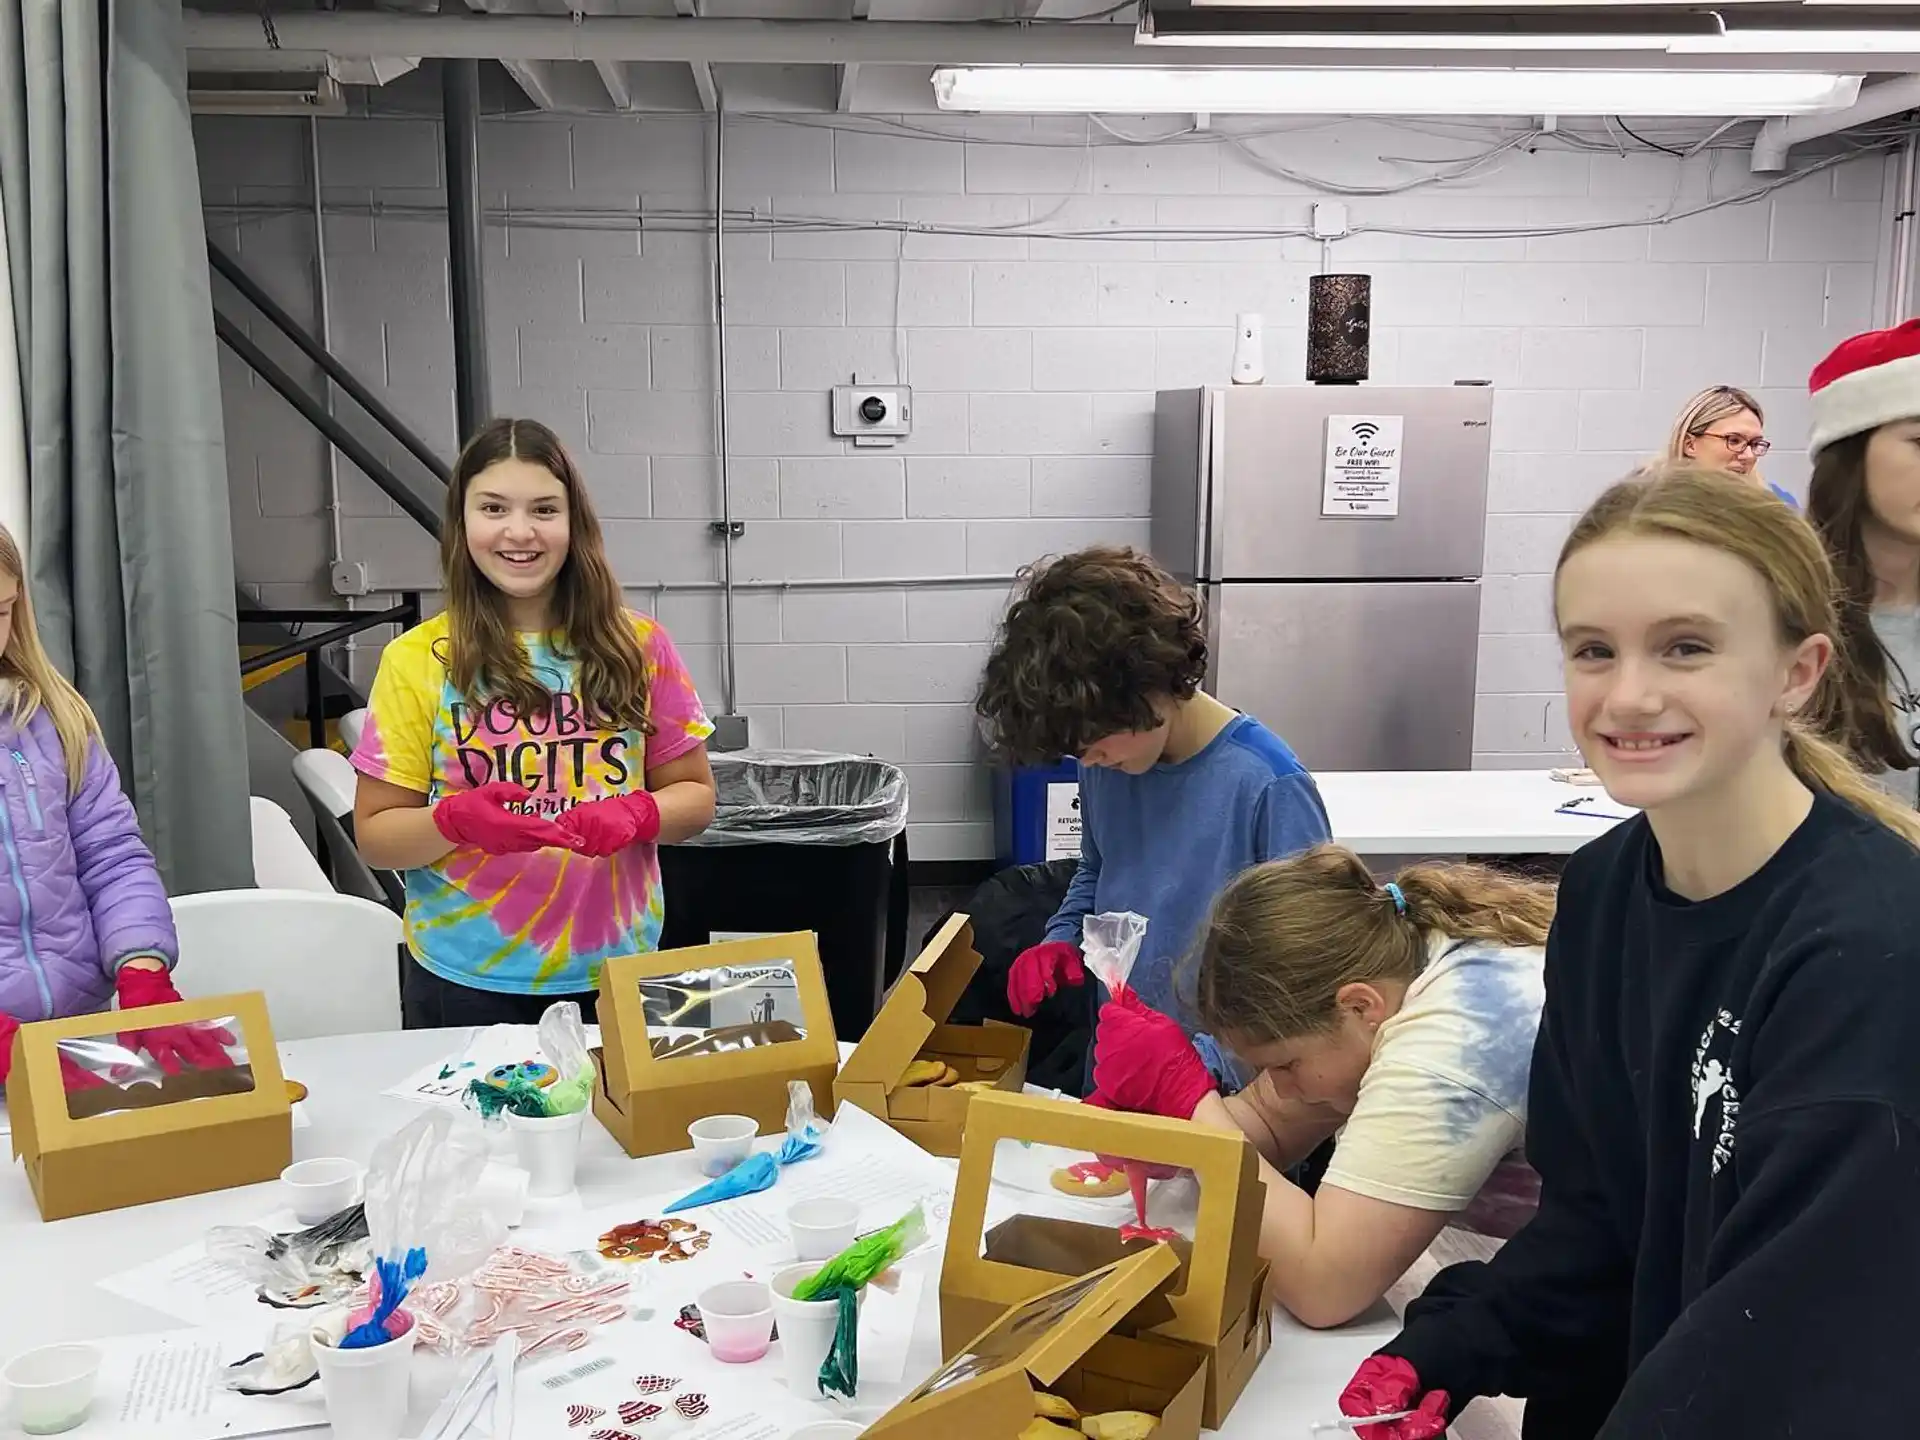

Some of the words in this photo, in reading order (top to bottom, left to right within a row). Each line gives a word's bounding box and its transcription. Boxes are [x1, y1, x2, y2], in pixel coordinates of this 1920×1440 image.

[1334, 446, 1348, 457] Be
[1350, 446, 1368, 457] Our
[1370, 446, 1396, 457] Guest
[451, 692, 628, 746] DOUBL
[456, 737, 628, 793] DIGITS
[773, 967, 794, 979] CA
